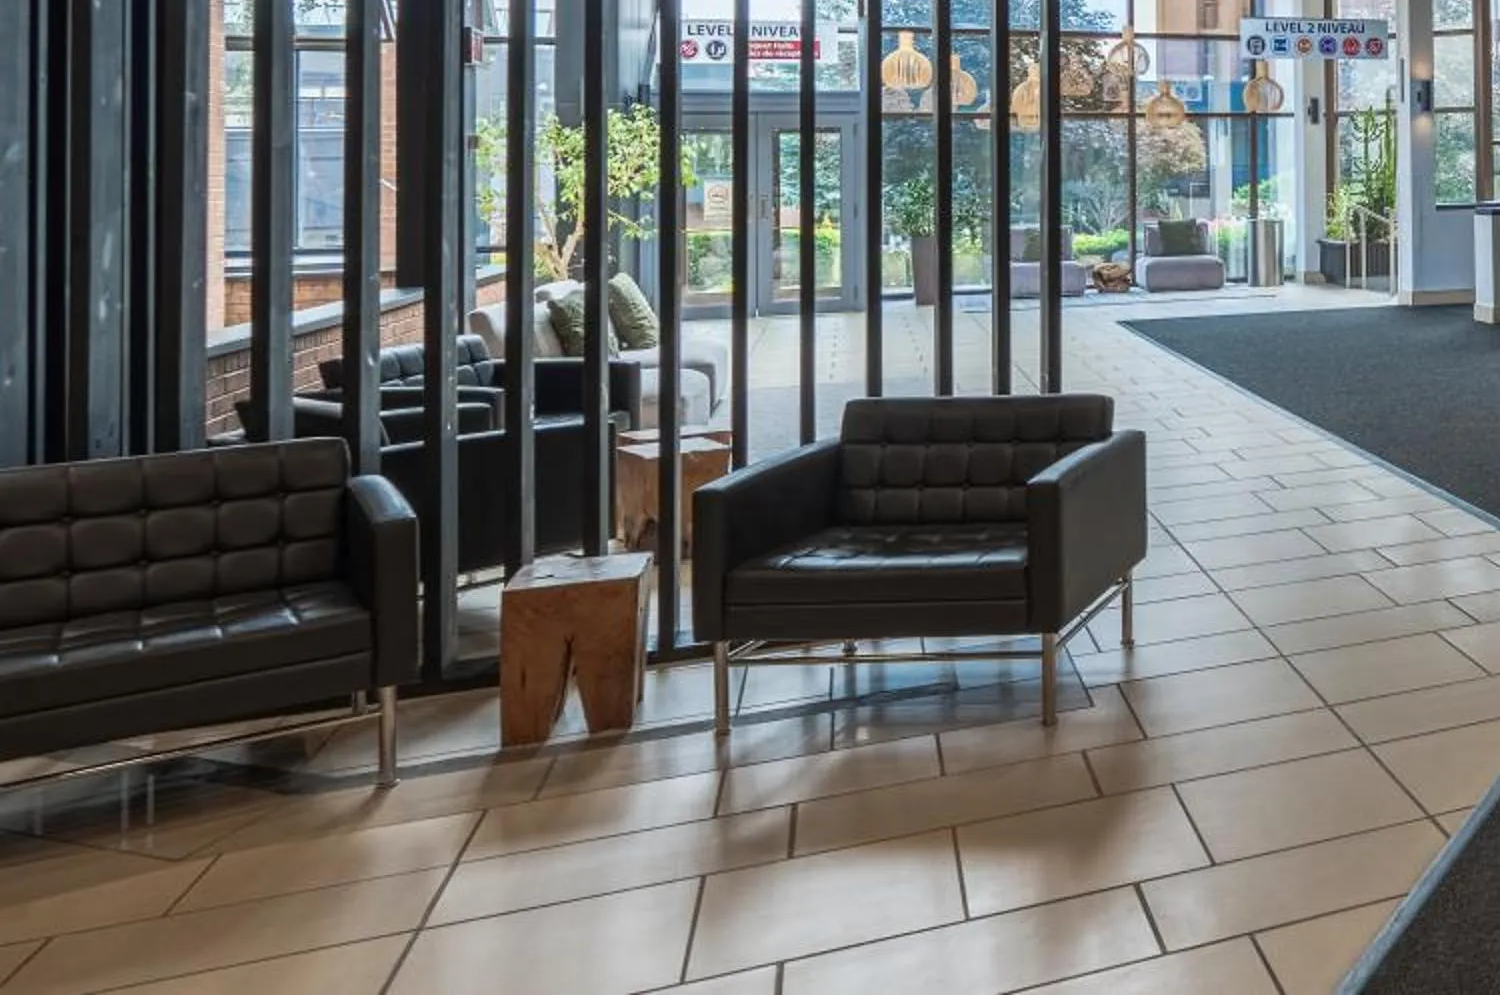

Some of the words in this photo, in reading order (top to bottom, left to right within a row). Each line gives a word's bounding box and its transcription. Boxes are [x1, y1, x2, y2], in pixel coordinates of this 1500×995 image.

[687, 24, 734, 36] LEVEL
[751, 25, 801, 37] NIVEA
[1265, 21, 1304, 33] LEVEL
[1307, 21, 1315, 33] 2
[1317, 21, 1365, 34] NIVEAU
